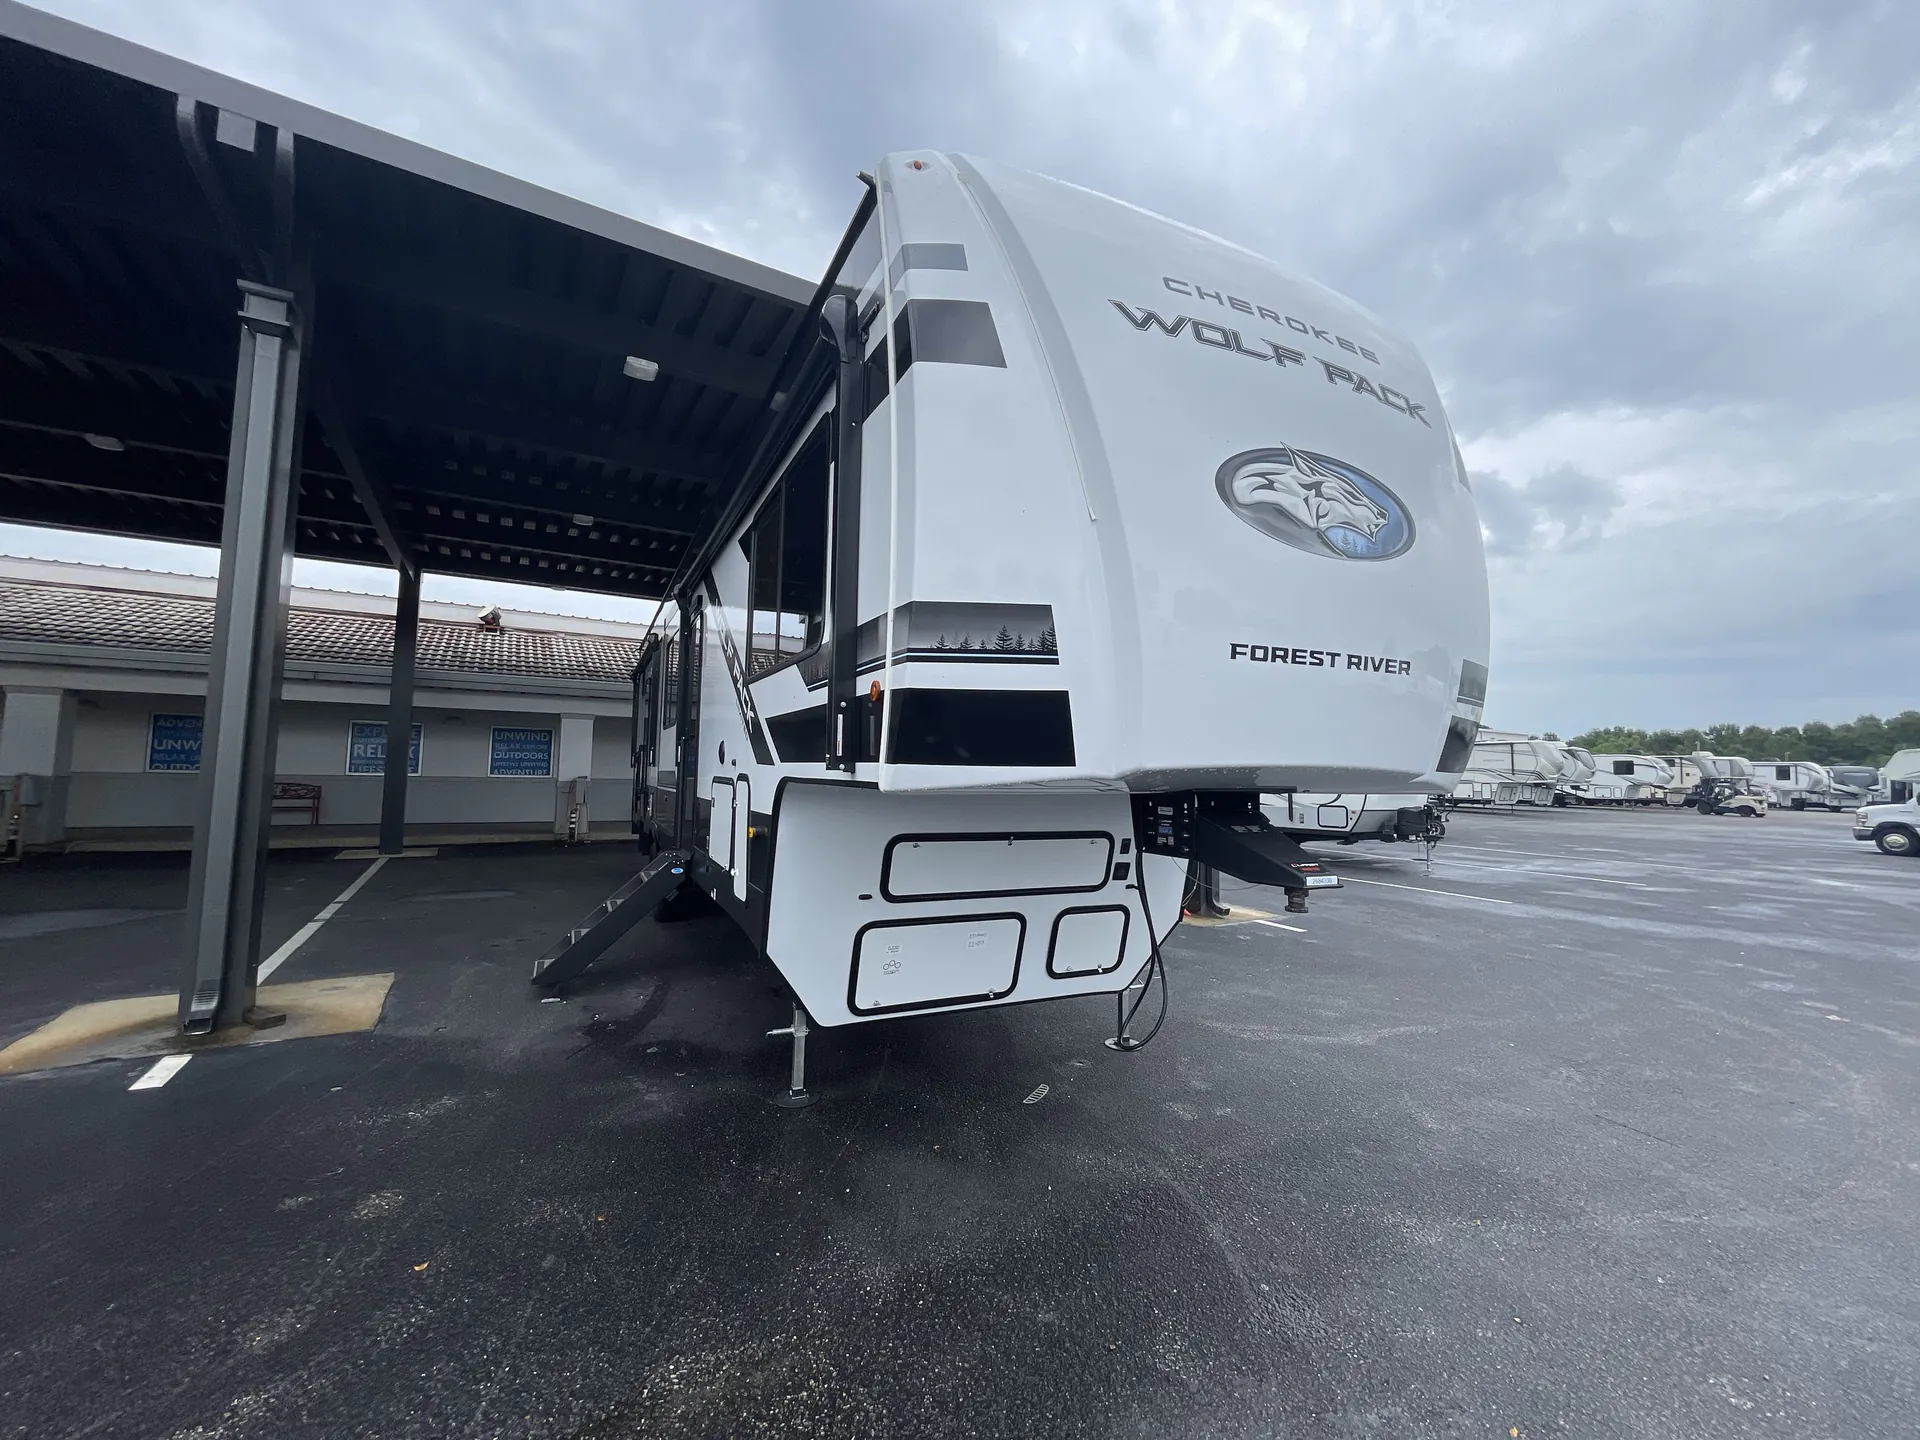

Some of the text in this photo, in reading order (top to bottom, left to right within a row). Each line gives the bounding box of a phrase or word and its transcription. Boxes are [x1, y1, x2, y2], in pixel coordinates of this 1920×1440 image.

[1161, 275, 1381, 366] CHEROKEE
[1107, 298, 1433, 429] WOLF PACK
[1229, 642, 1411, 676] FOREST RIVER
[733, 656, 755, 734] PACK
[495, 731, 550, 741] UNWIND
[495, 742, 521, 750] RELAX
[494, 751, 549, 760] OUTDOORS
[493, 768, 549, 776] ADVENTURE
